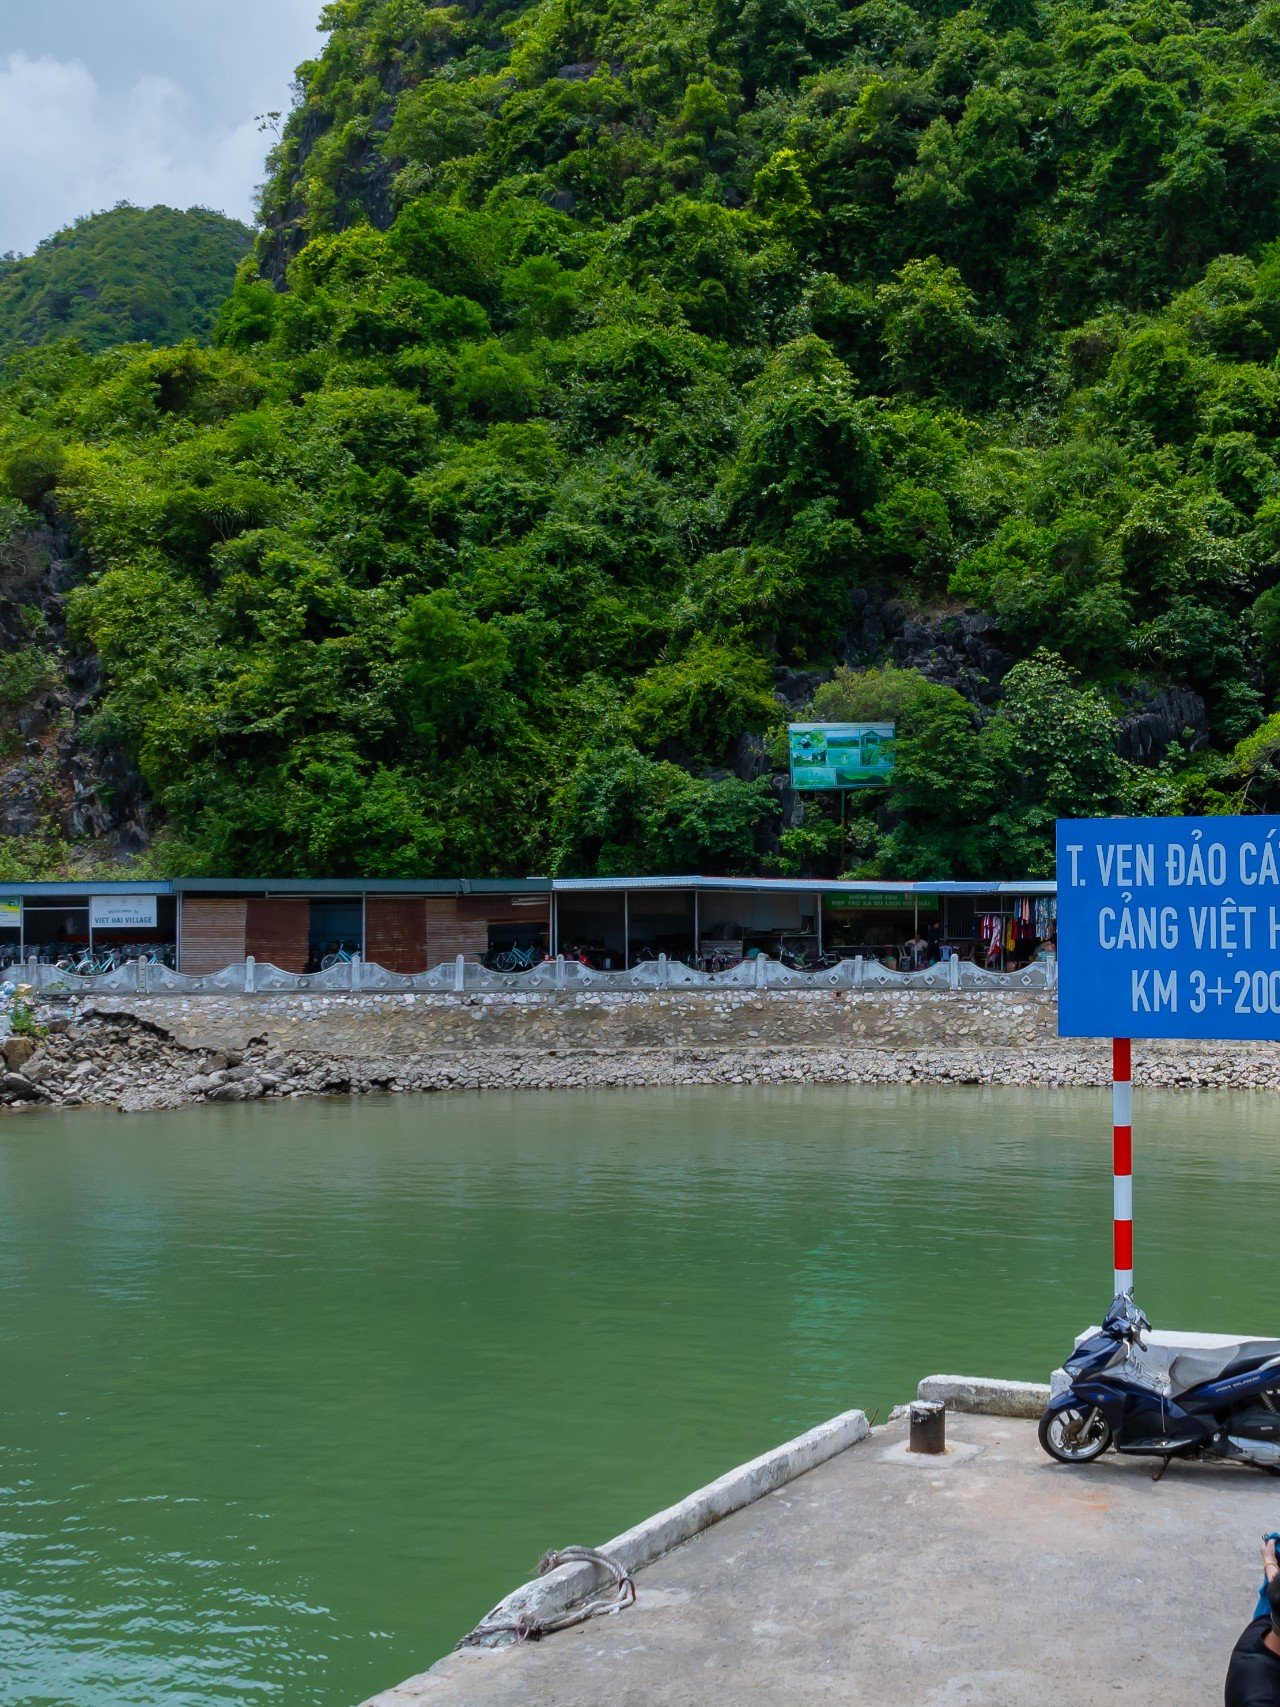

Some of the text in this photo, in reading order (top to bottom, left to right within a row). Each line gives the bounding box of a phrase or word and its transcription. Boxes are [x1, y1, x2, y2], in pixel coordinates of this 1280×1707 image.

[1066, 844, 1086, 887] T.
[1096, 843, 1155, 887] VEN
[1164, 828, 1226, 886] ĐẢO
[1098, 891, 1179, 950] CẢNG
[1188, 897, 1257, 958] VIỆT
[1131, 969, 1178, 1012] KM
